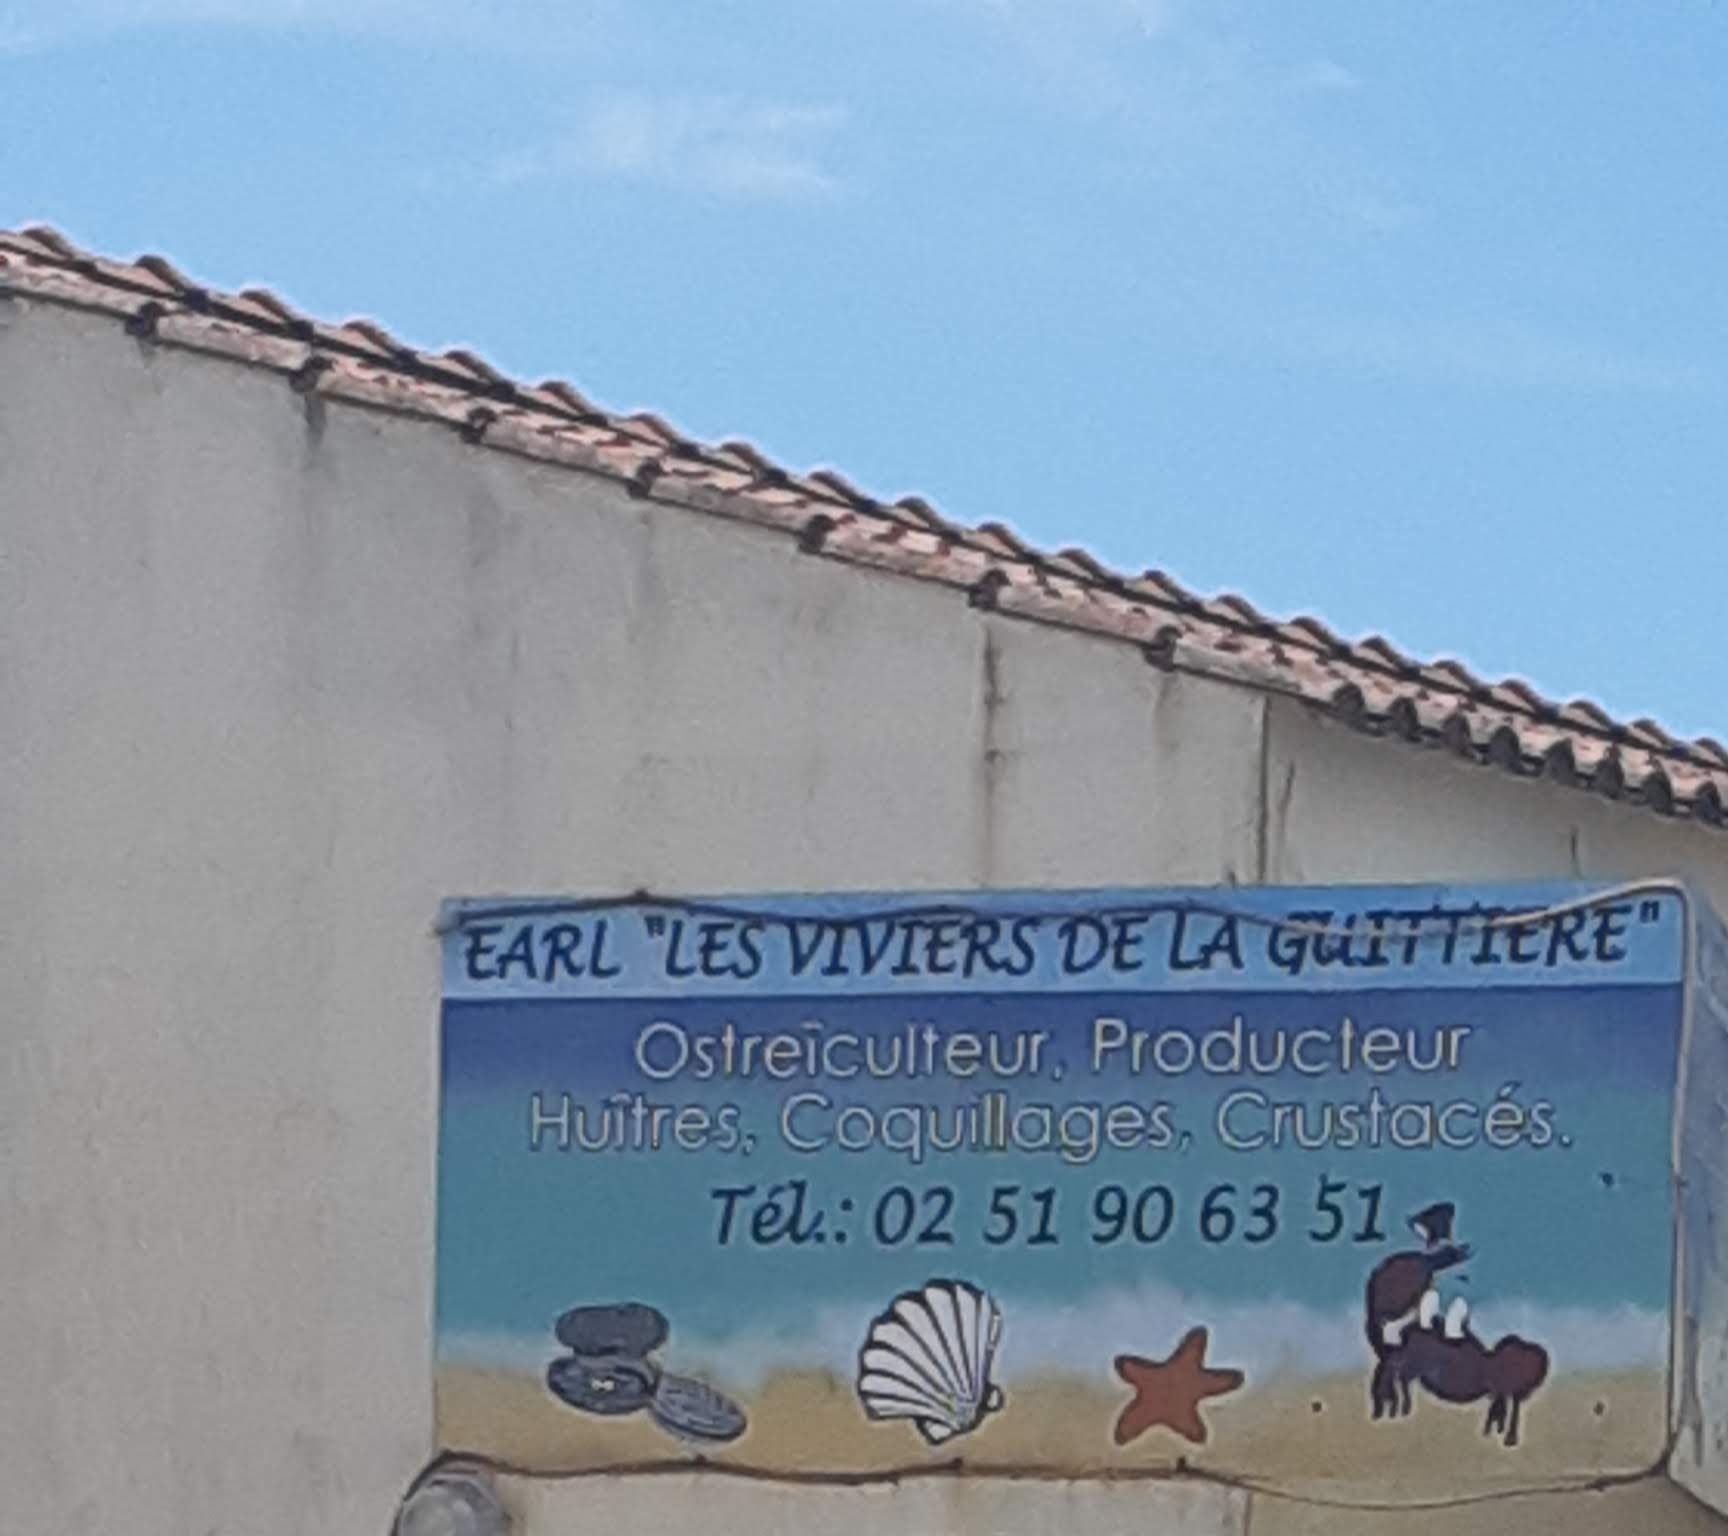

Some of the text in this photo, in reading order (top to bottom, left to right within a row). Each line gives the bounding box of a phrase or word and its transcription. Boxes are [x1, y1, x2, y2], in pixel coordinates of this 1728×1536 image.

[466, 919, 622, 982] EARL
[644, 914, 766, 980] "LES
[786, 916, 1040, 979] VIVIERS
[1058, 913, 1150, 975] DE
[1168, 907, 1246, 972] LA
[1091, 1016, 1473, 1076] Producteur
[525, 1082, 1573, 1165] Huîtres, Coquillages, Crustacés.
[872, 1185, 955, 1246] 02
[982, 1185, 1059, 1246] 51
[1090, 1183, 1174, 1244] 90
[1198, 1183, 1281, 1243] 63
[1308, 1180, 1389, 1244] 51
